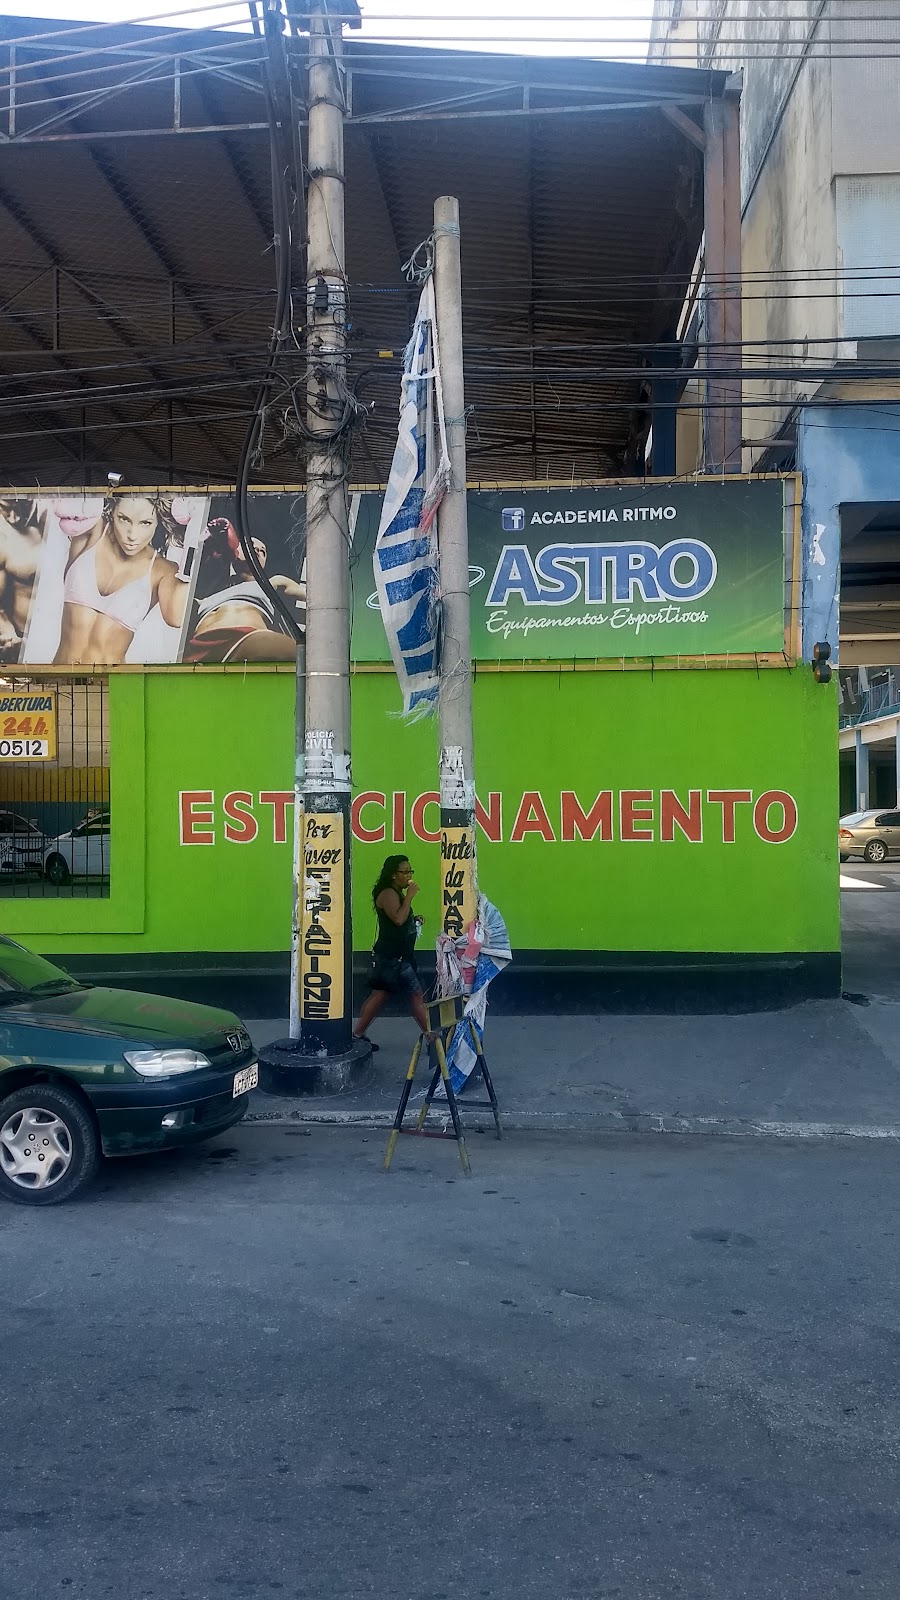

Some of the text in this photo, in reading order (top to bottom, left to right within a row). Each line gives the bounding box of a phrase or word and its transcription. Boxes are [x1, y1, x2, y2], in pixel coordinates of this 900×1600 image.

[530, 509, 619, 525] ACADEMIA
[622, 506, 677, 522] RITMO
[484, 537, 718, 607] ASTRO
[485, 609, 609, 640] Equipamentos
[0, 696, 53, 712] BERTURA
[305, 738, 333, 750] CIVIL
[179, 789, 798, 846] ESTCIONAMENTO
[445, 863, 465, 888] da
[443, 889, 464, 939] MAR
